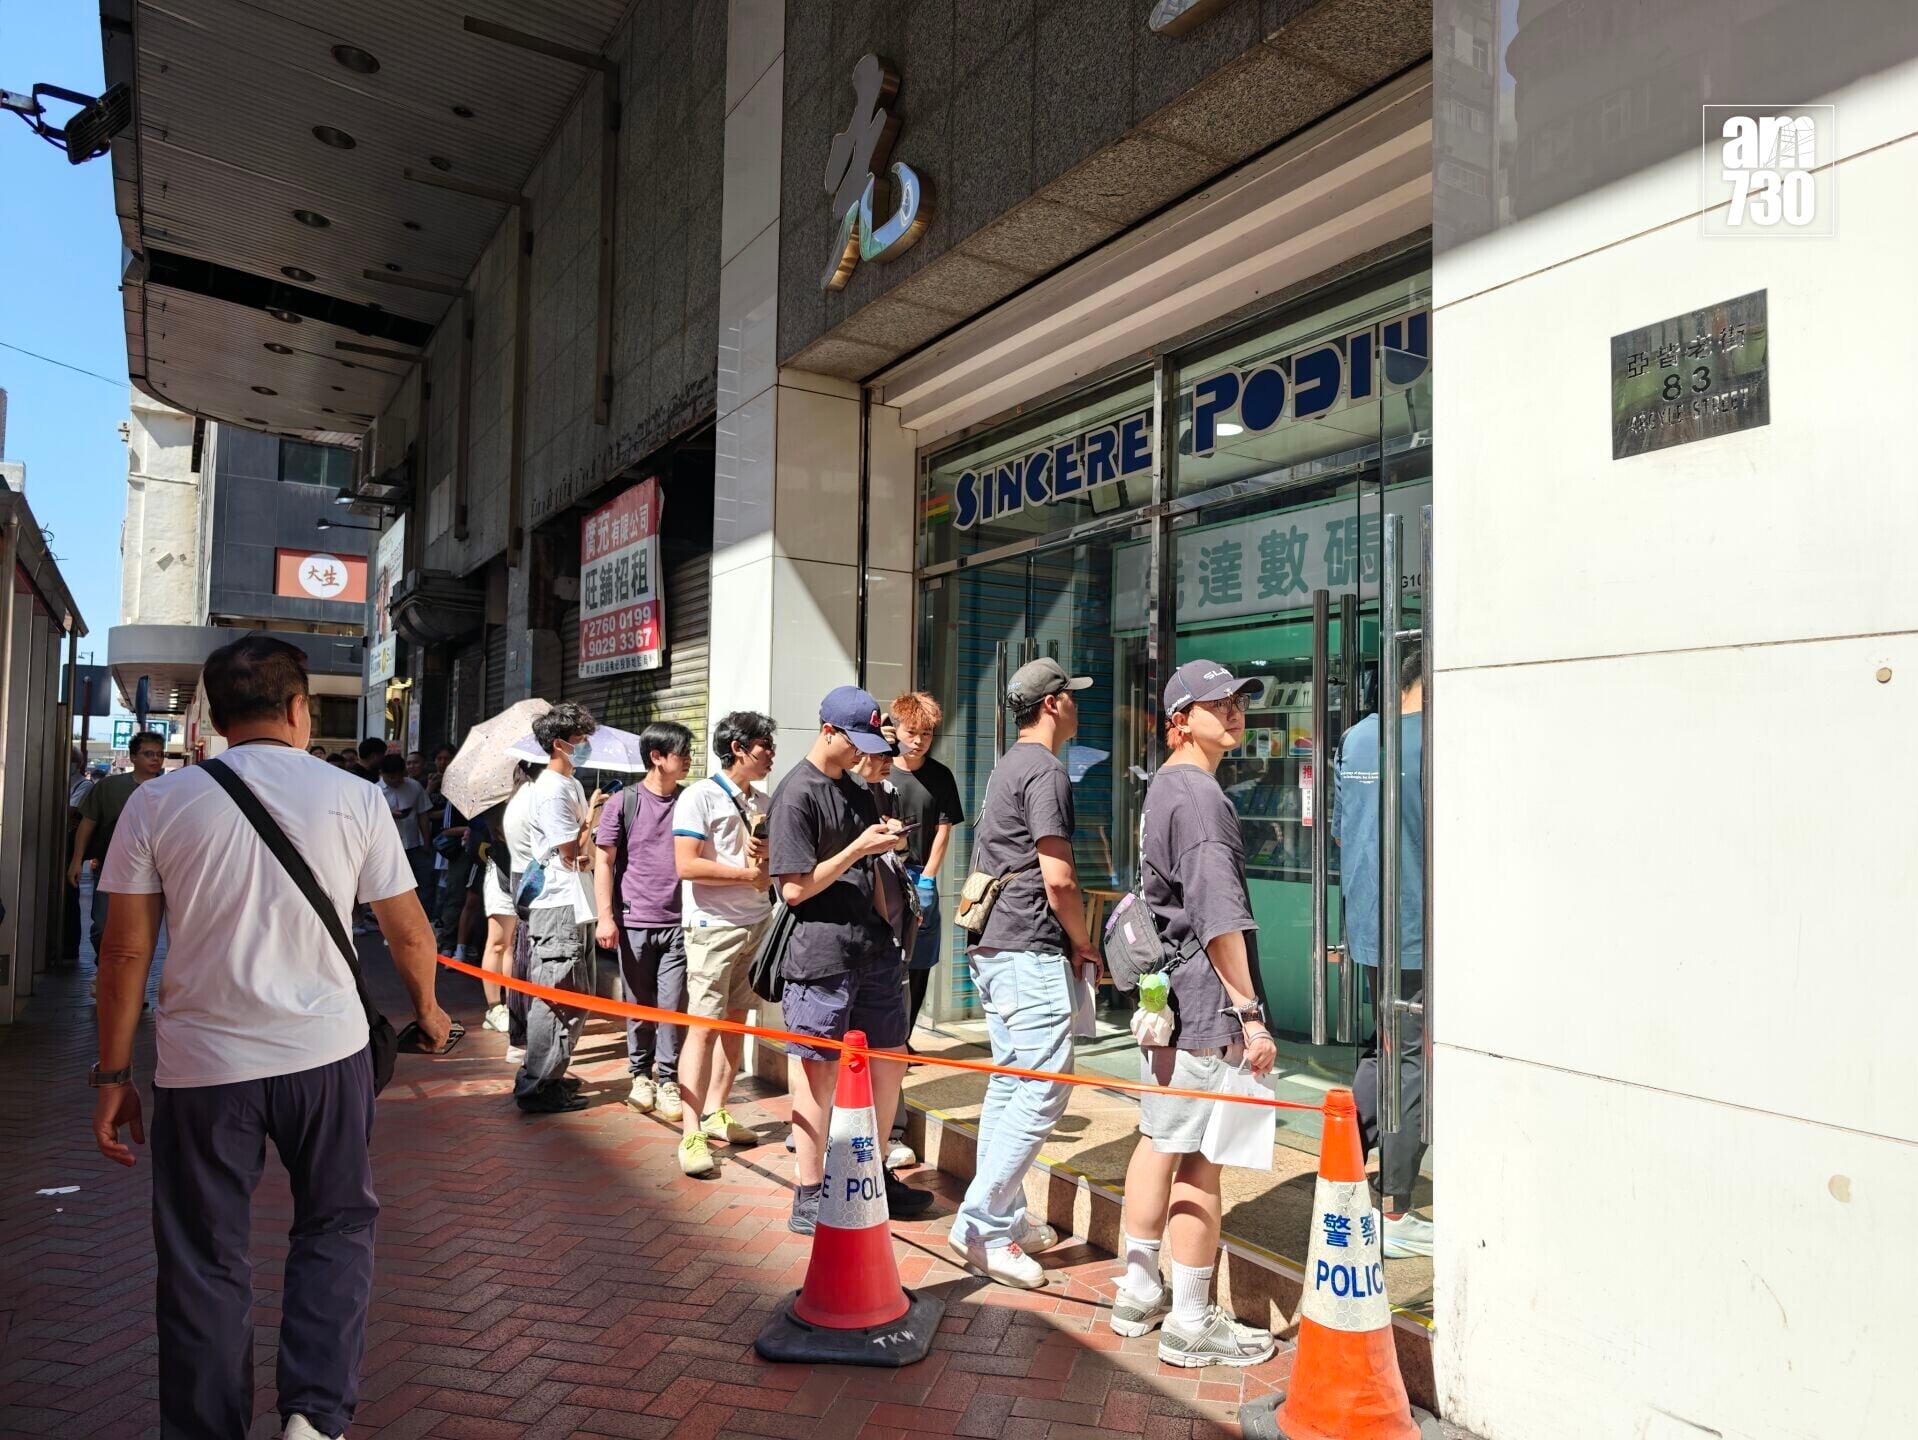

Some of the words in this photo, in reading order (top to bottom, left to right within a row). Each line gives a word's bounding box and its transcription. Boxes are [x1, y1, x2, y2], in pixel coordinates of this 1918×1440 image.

[1627, 323, 1746, 379] 亞皆老街
[1662, 366, 1712, 401] 83
[1693, 388, 1749, 419] STREET
[953, 411, 1153, 531] SINCERE
[307, 565, 340, 587] 大生
[588, 617, 616, 638] 2760
[619, 606, 652, 631] 0199
[588, 636, 616, 657] 9029
[619, 627, 653, 651] 3367
[850, 1136, 875, 1163] 警
[872, 1330, 917, 1349] TKW
